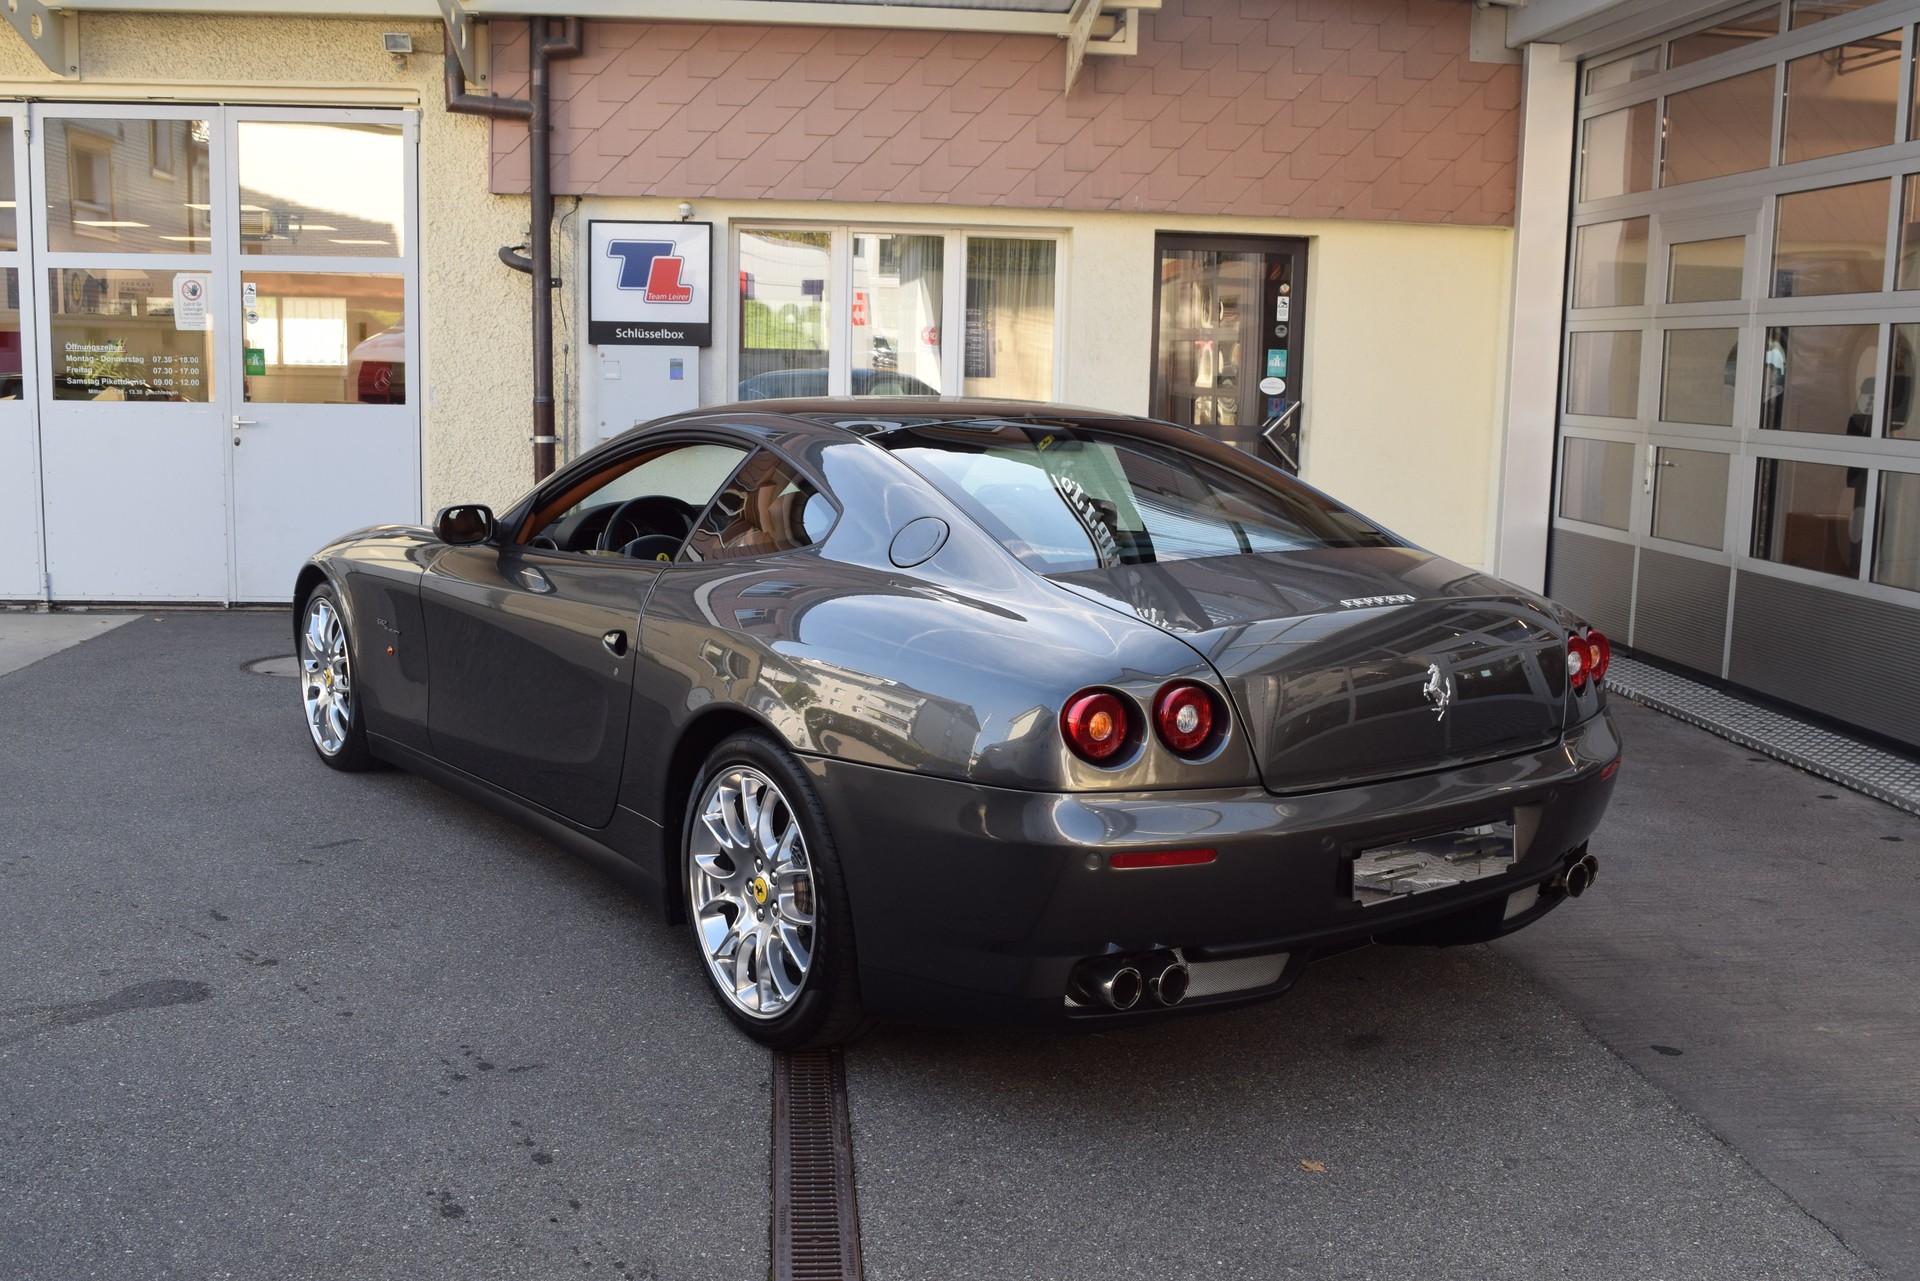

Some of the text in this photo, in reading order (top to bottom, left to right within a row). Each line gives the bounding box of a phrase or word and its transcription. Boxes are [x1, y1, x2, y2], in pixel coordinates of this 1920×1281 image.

[668, 293, 690, 301] Leirer
[615, 327, 684, 339] Schlüsselbox
[65, 342, 126, 352] Öffnungszeiten:
[66, 355, 94, 363] Montag
[100, 356, 144, 365] Donnerstag
[66, 366, 93, 374] Freitag
[66, 378, 100, 386] Samstag
